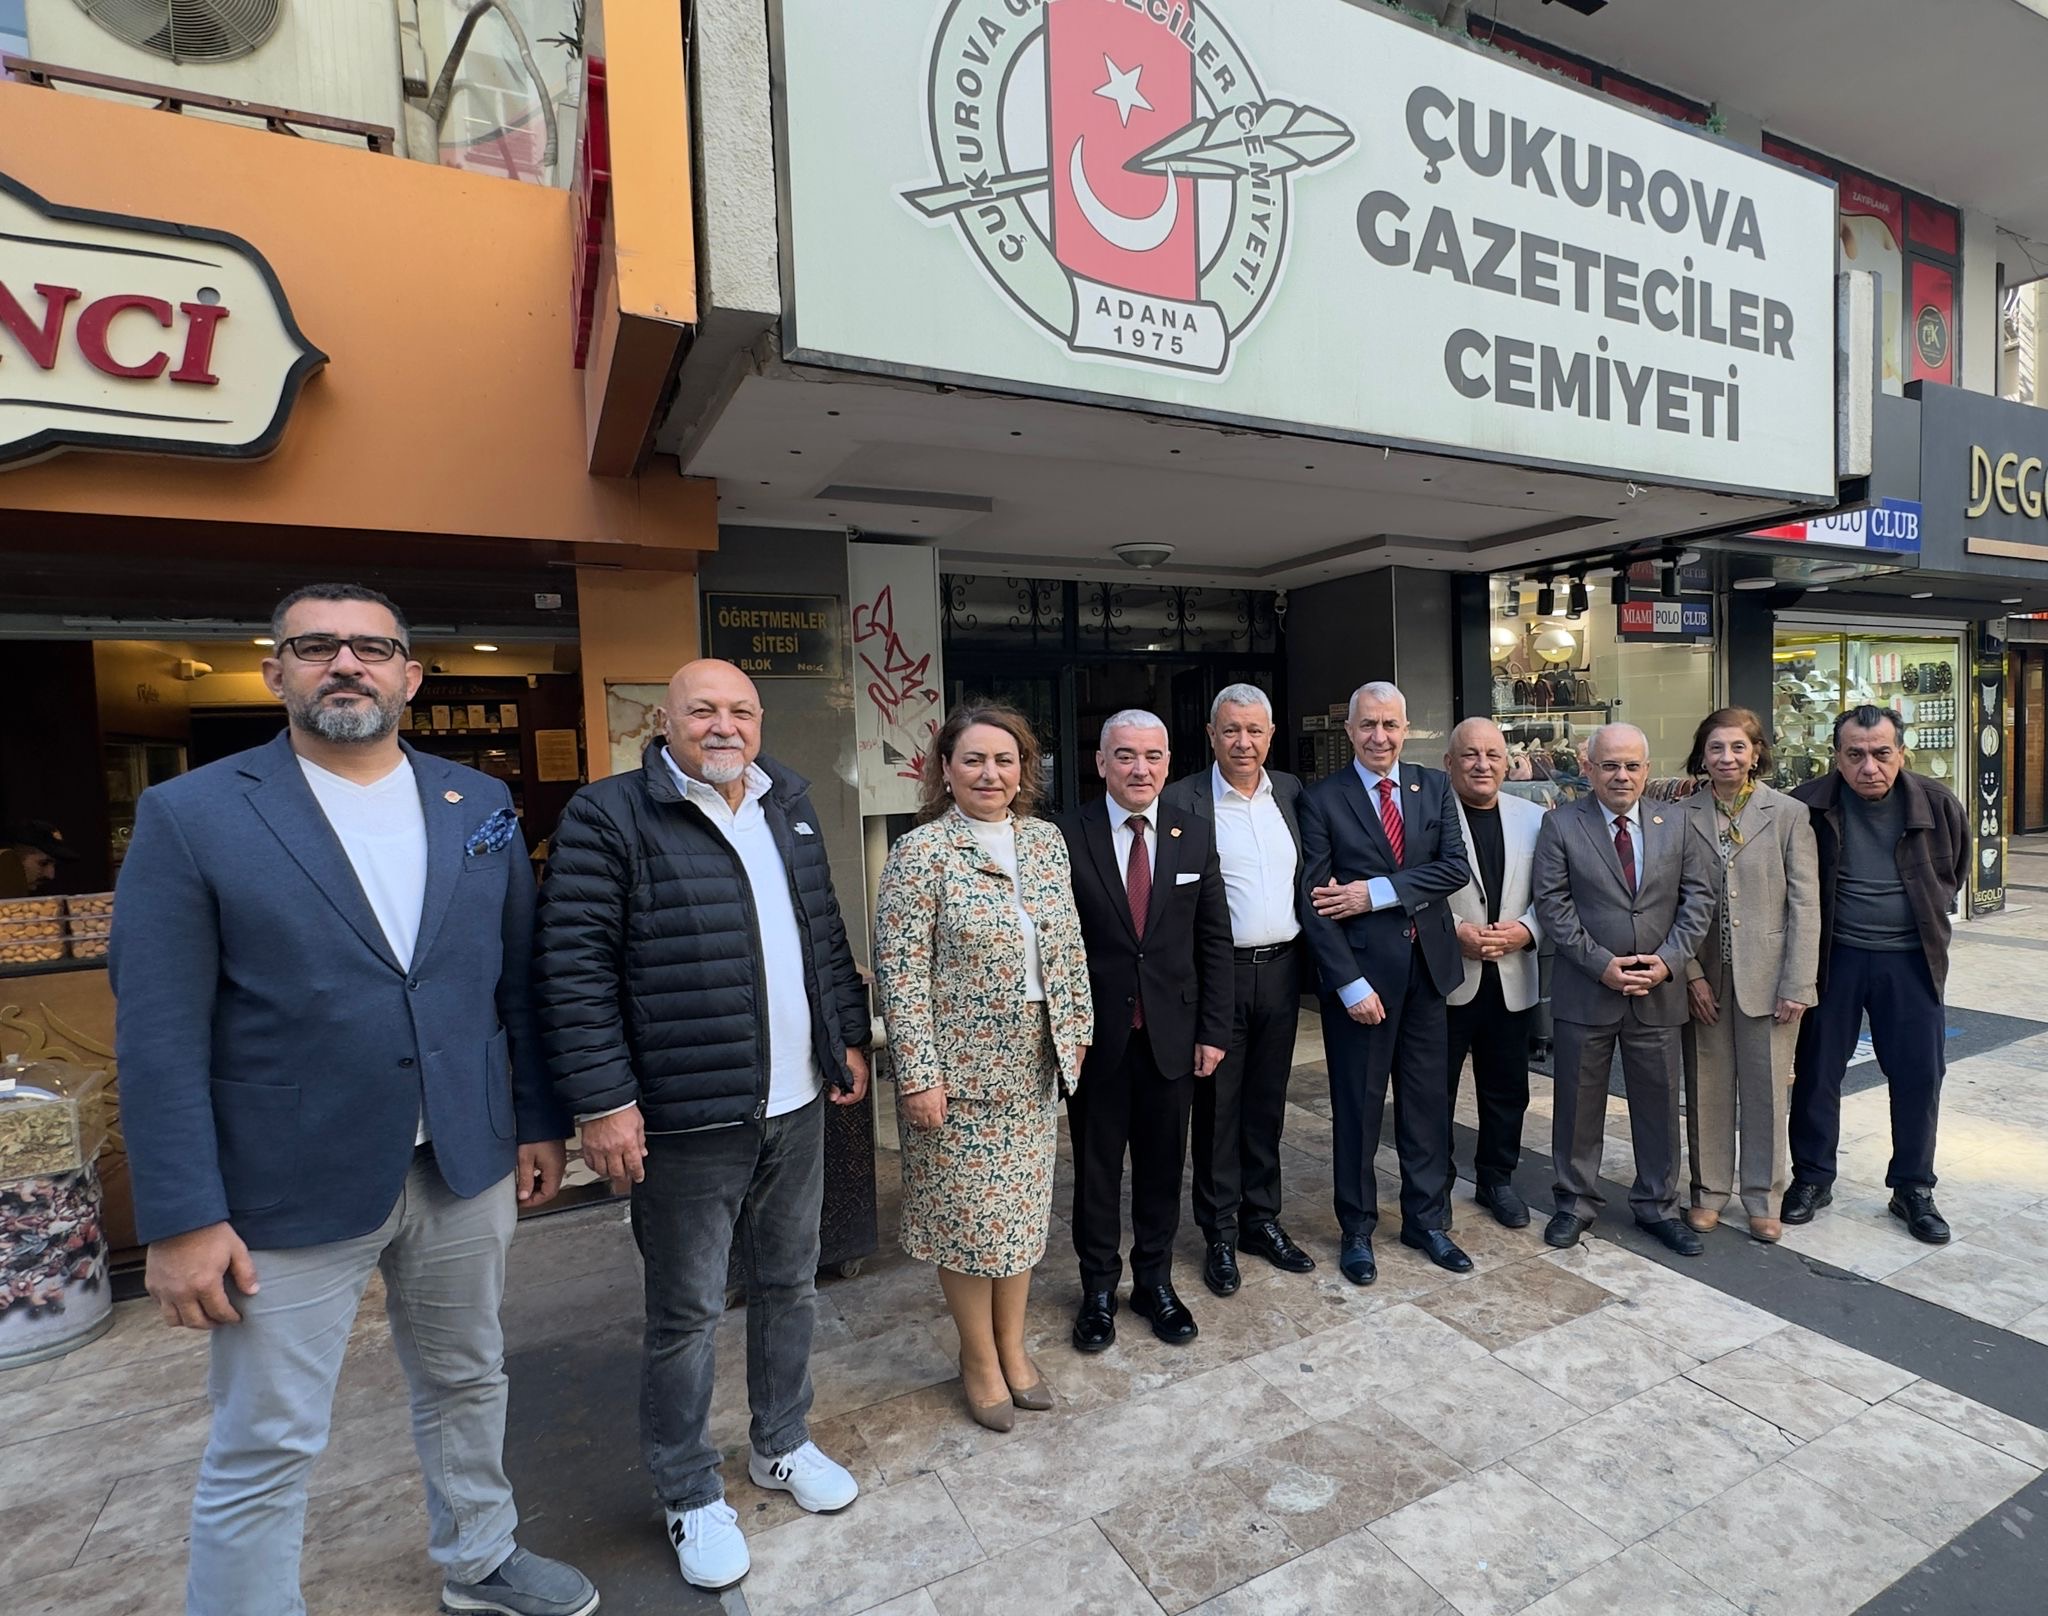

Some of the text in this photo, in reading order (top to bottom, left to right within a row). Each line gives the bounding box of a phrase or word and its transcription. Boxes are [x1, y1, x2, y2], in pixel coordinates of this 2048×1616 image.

[954, 0, 1278, 296] ÇUKUROVA GCİLER CEMİYETİ
[1406, 86, 1766, 261] ÇUKUROVA
[1356, 190, 1795, 361] GAZETECİLER
[1096, 296, 1198, 333] ADANA
[1112, 326, 1184, 355] 1975
[1444, 328, 1740, 442] CEMİYETİ
[1965, 445, 2048, 520] DEG
[1871, 508, 1919, 540] CLUB
[718, 606, 828, 630] ÖĞRETMENLER
[1623, 608, 1708, 626] MIAMI POLO CLUB
[752, 632, 800, 653] SİTESİ
[741, 658, 772, 671] BLOK
